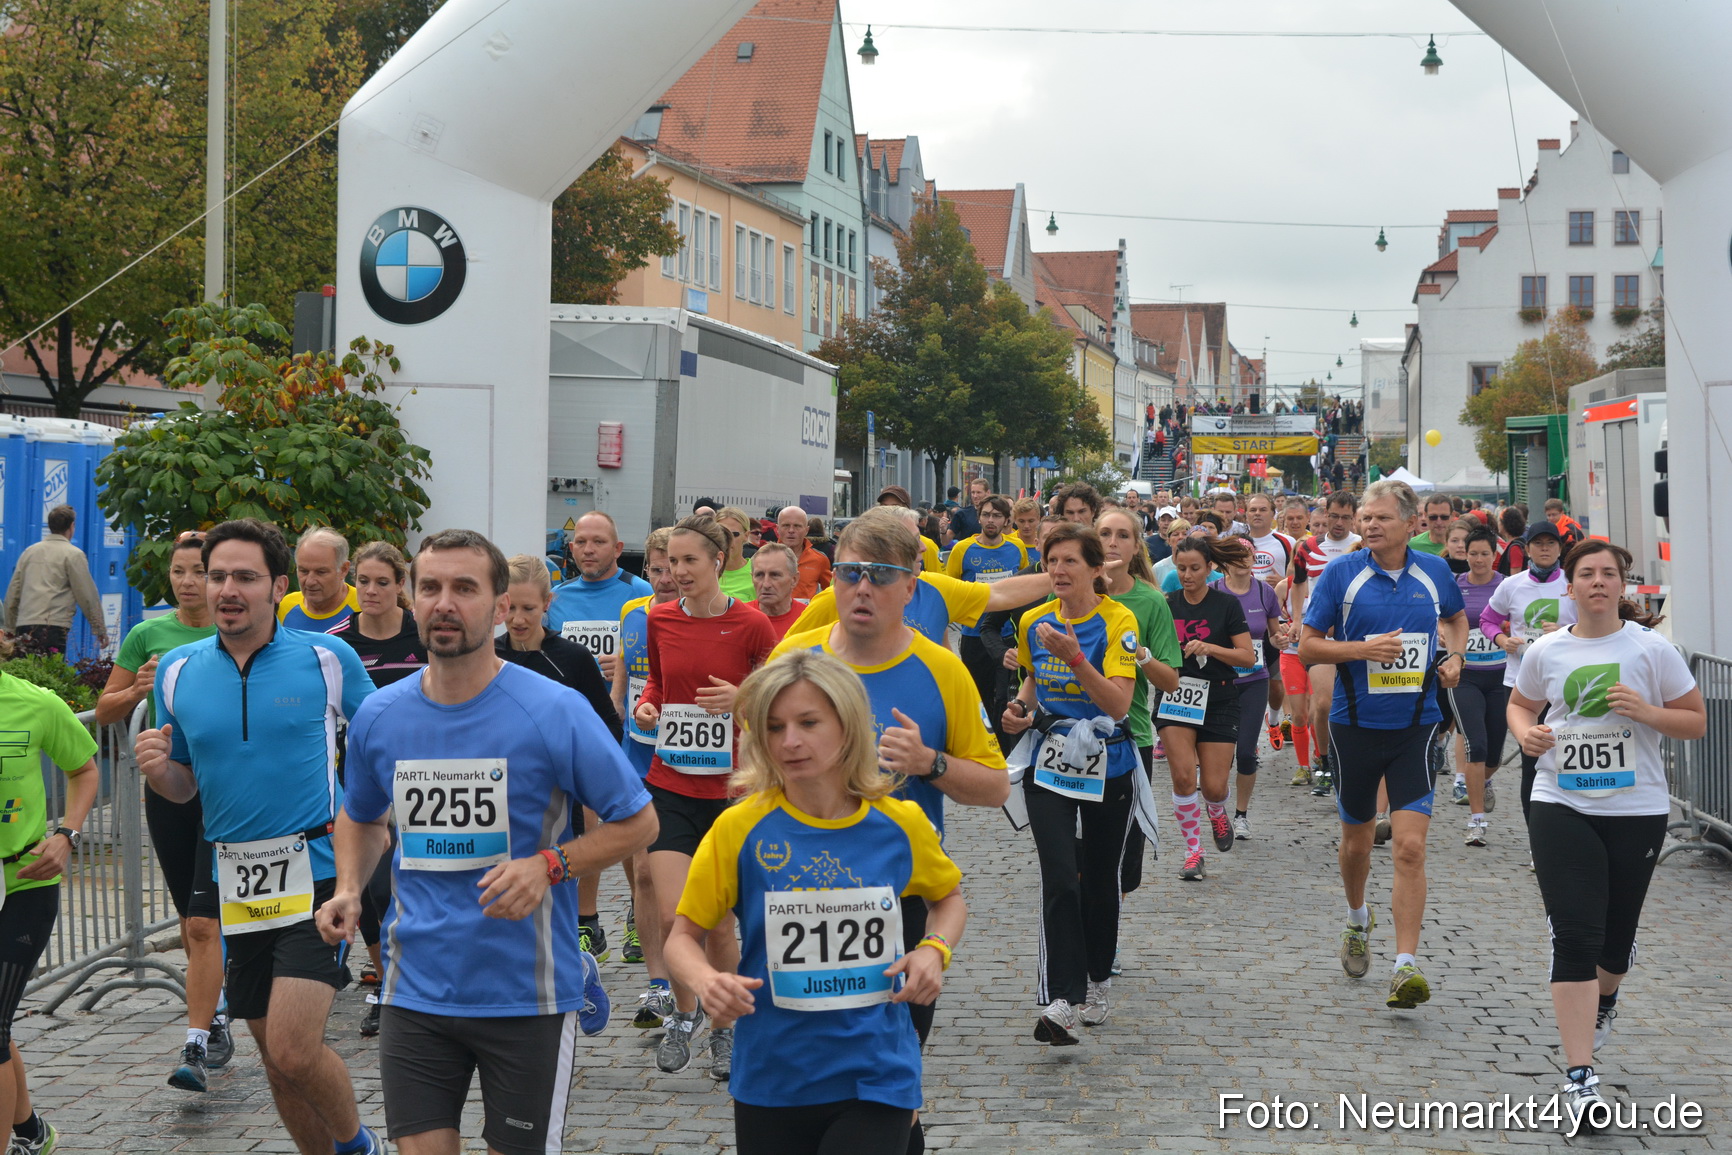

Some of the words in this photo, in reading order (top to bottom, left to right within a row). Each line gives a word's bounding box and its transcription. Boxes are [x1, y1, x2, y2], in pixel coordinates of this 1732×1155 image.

[367, 209, 458, 248] BMW
[802, 405, 830, 449] BOCK
[1233, 440, 1276, 450] START
[1381, 676, 1420, 686] Wolfgang
[1165, 705, 1191, 718] Kerstin
[664, 721, 725, 748] 2569
[1557, 733, 1581, 741] PARTL
[1582, 732, 1620, 740] Neumarkt
[670, 753, 717, 765] Katharina
[1563, 742, 1625, 770] 2051
[396, 771, 430, 781] PARTL
[432, 770, 485, 781] Neumarkt
[1576, 776, 1616, 788] Sabrina
[1053, 776, 1085, 790] Renate
[405, 787, 496, 827] 2255
[219, 851, 242, 860] PARTL
[243, 846, 290, 860] Neumarkt
[426, 839, 475, 855] Roland
[763, 852, 784, 860] Jahre
[236, 859, 290, 898] 327
[246, 902, 281, 918] Bernd
[769, 904, 812, 915] PARTL
[816, 901, 876, 914] Neumarkt
[781, 917, 885, 965] 2128
[803, 976, 866, 996] Justyna
